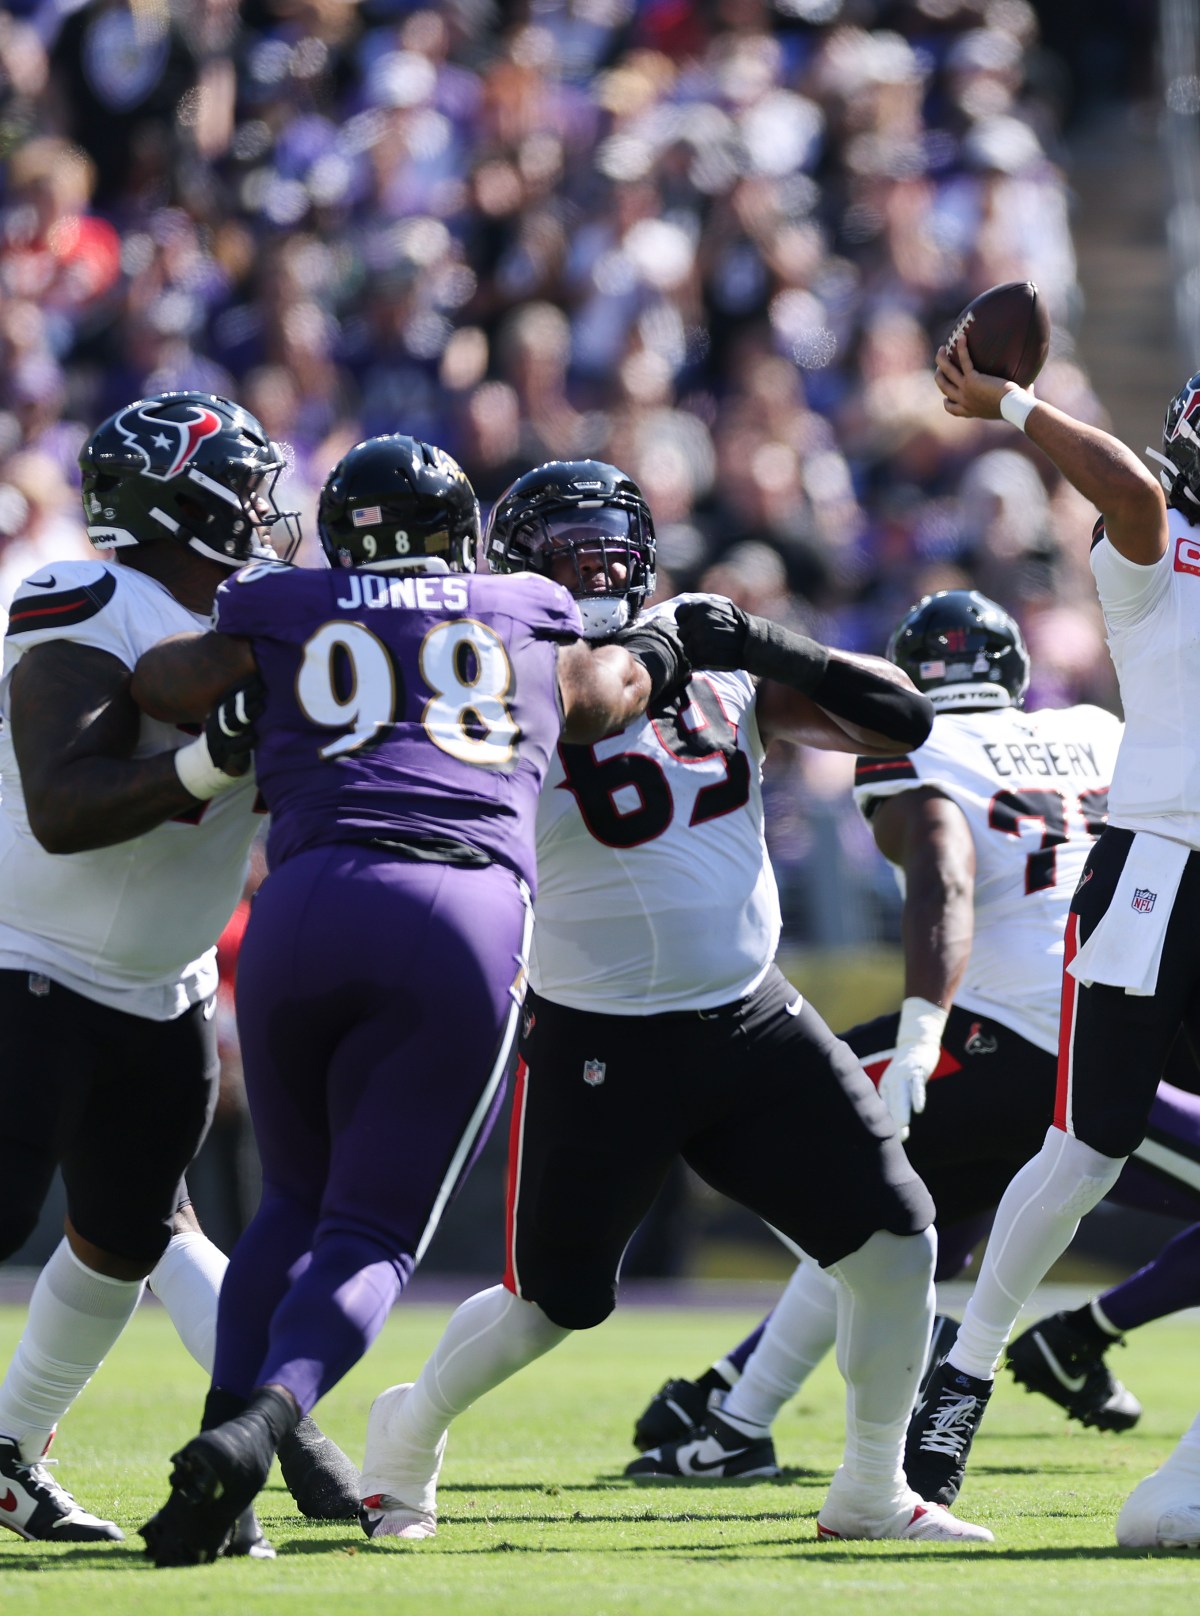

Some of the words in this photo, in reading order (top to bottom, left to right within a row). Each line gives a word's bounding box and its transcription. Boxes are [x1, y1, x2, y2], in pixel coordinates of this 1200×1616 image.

[337, 573, 469, 612] JONES
[294, 617, 524, 766] 98
[981, 742, 1101, 778] ERSERY
